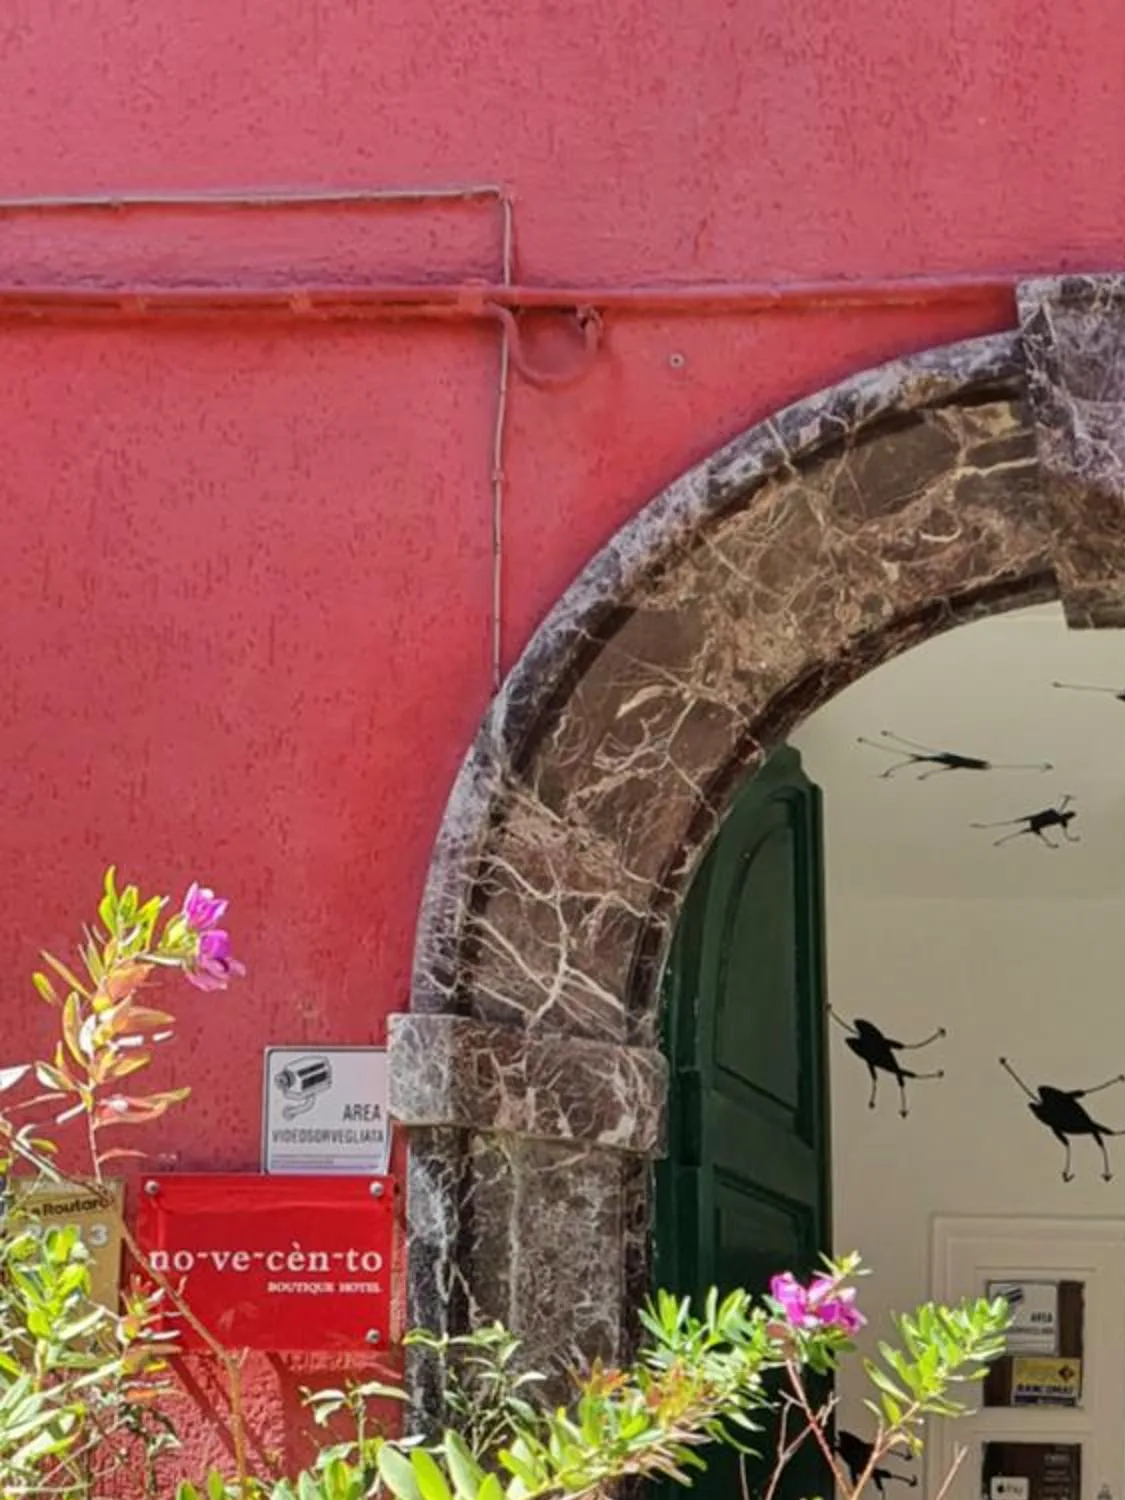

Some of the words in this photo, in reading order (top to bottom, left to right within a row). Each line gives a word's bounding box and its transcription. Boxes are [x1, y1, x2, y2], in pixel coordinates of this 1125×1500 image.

[343, 1103, 382, 1121] AREA
[271, 1129, 384, 1143] VIDEOSORVEGLIATA
[149, 1241, 383, 1272] no-ve-cèn-to
[267, 1281, 334, 1293] BOUTIQUE
[339, 1281, 382, 1293] HOTEL
